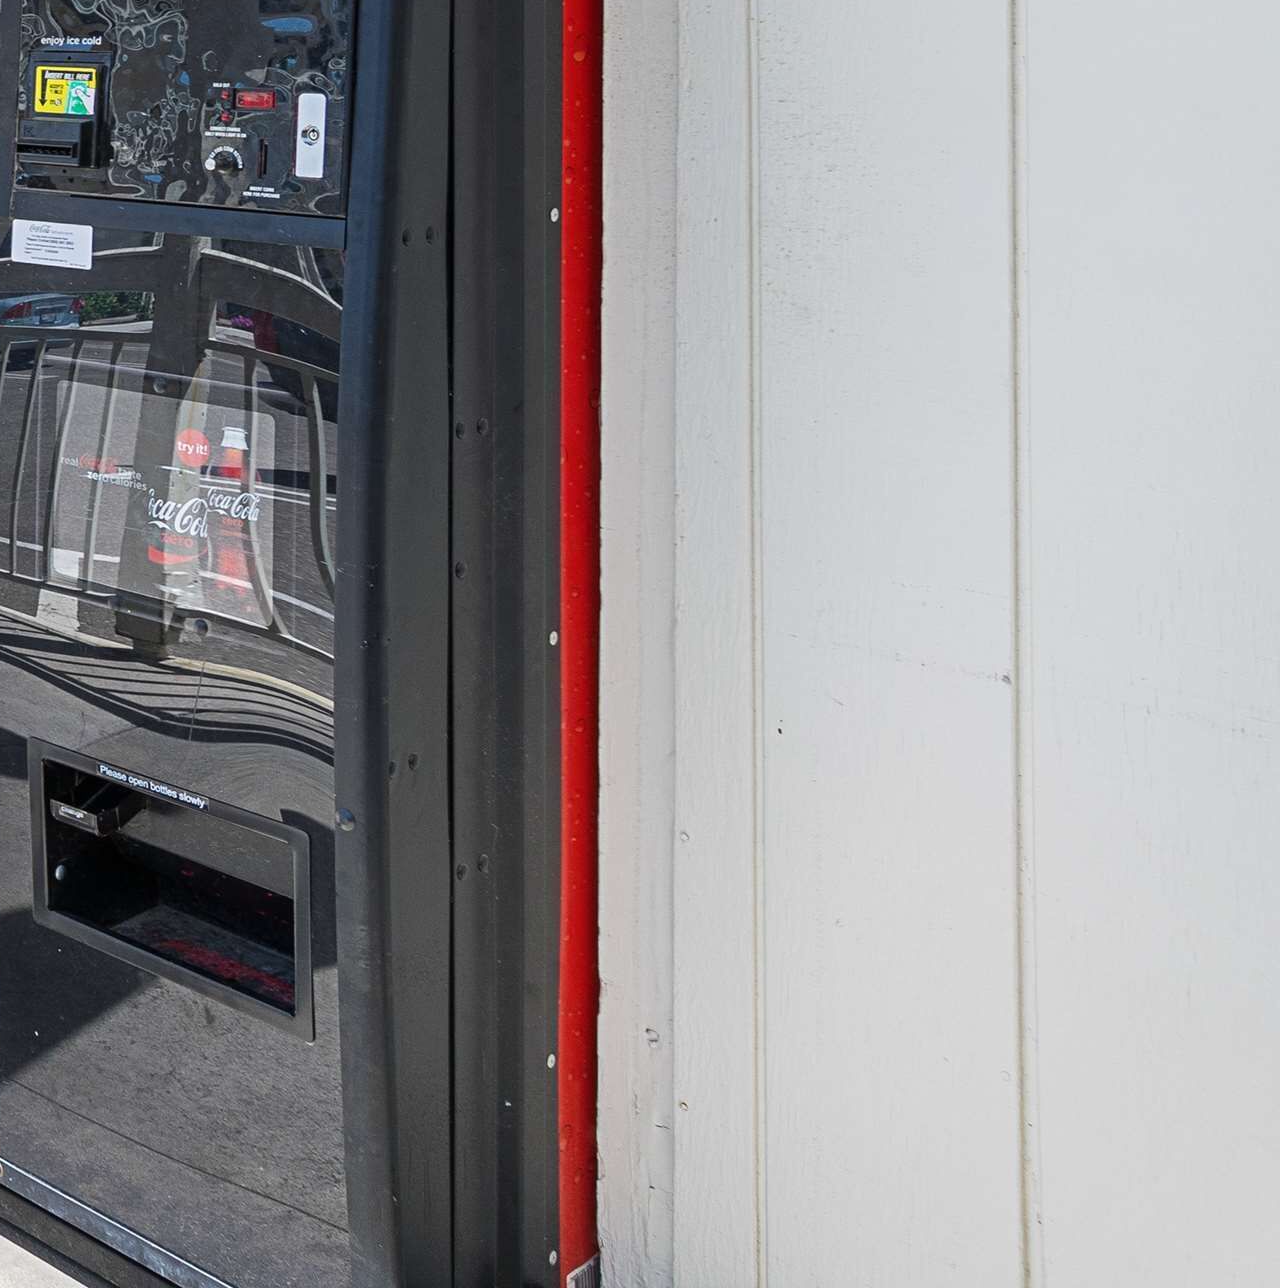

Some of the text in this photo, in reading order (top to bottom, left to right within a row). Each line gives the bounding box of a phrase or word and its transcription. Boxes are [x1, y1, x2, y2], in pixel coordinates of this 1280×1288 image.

[40, 35, 102, 47] enjoy ice cold
[177, 442, 208, 456] try it!
[99, 764, 206, 809] Please open bottles slowly
